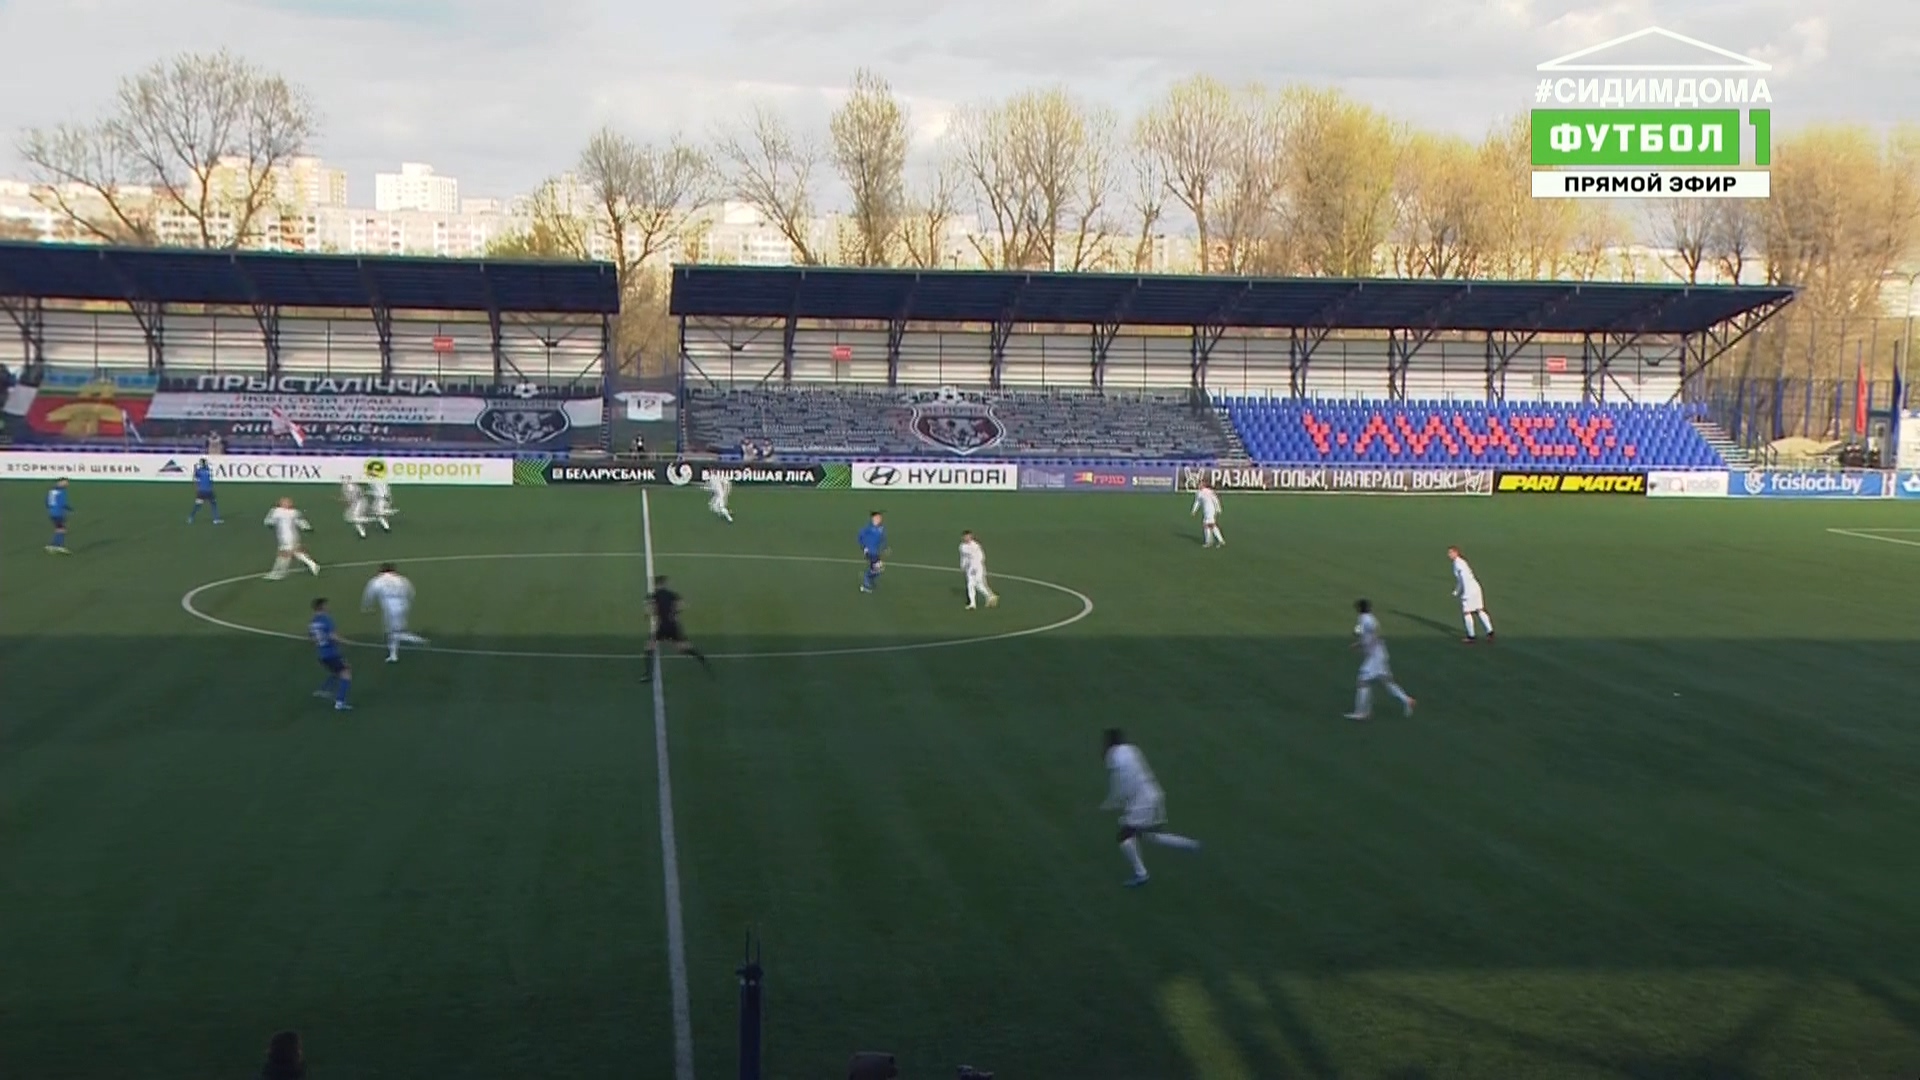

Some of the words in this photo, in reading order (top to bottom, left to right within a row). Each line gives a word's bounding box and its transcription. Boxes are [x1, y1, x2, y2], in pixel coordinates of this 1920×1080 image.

[197, 373, 441, 395] ПРЫСТАЛІЧЧА
[392, 460, 484, 477] евроопт
[566, 467, 656, 481] БЕЛАРУСБАНК
[785, 470, 815, 482] ЛІГА
[908, 468, 1007, 485] HYUNDAI
[1211, 469, 1266, 490] РАЗАМ,
[1772, 471, 1863, 494] fcisloch.by
